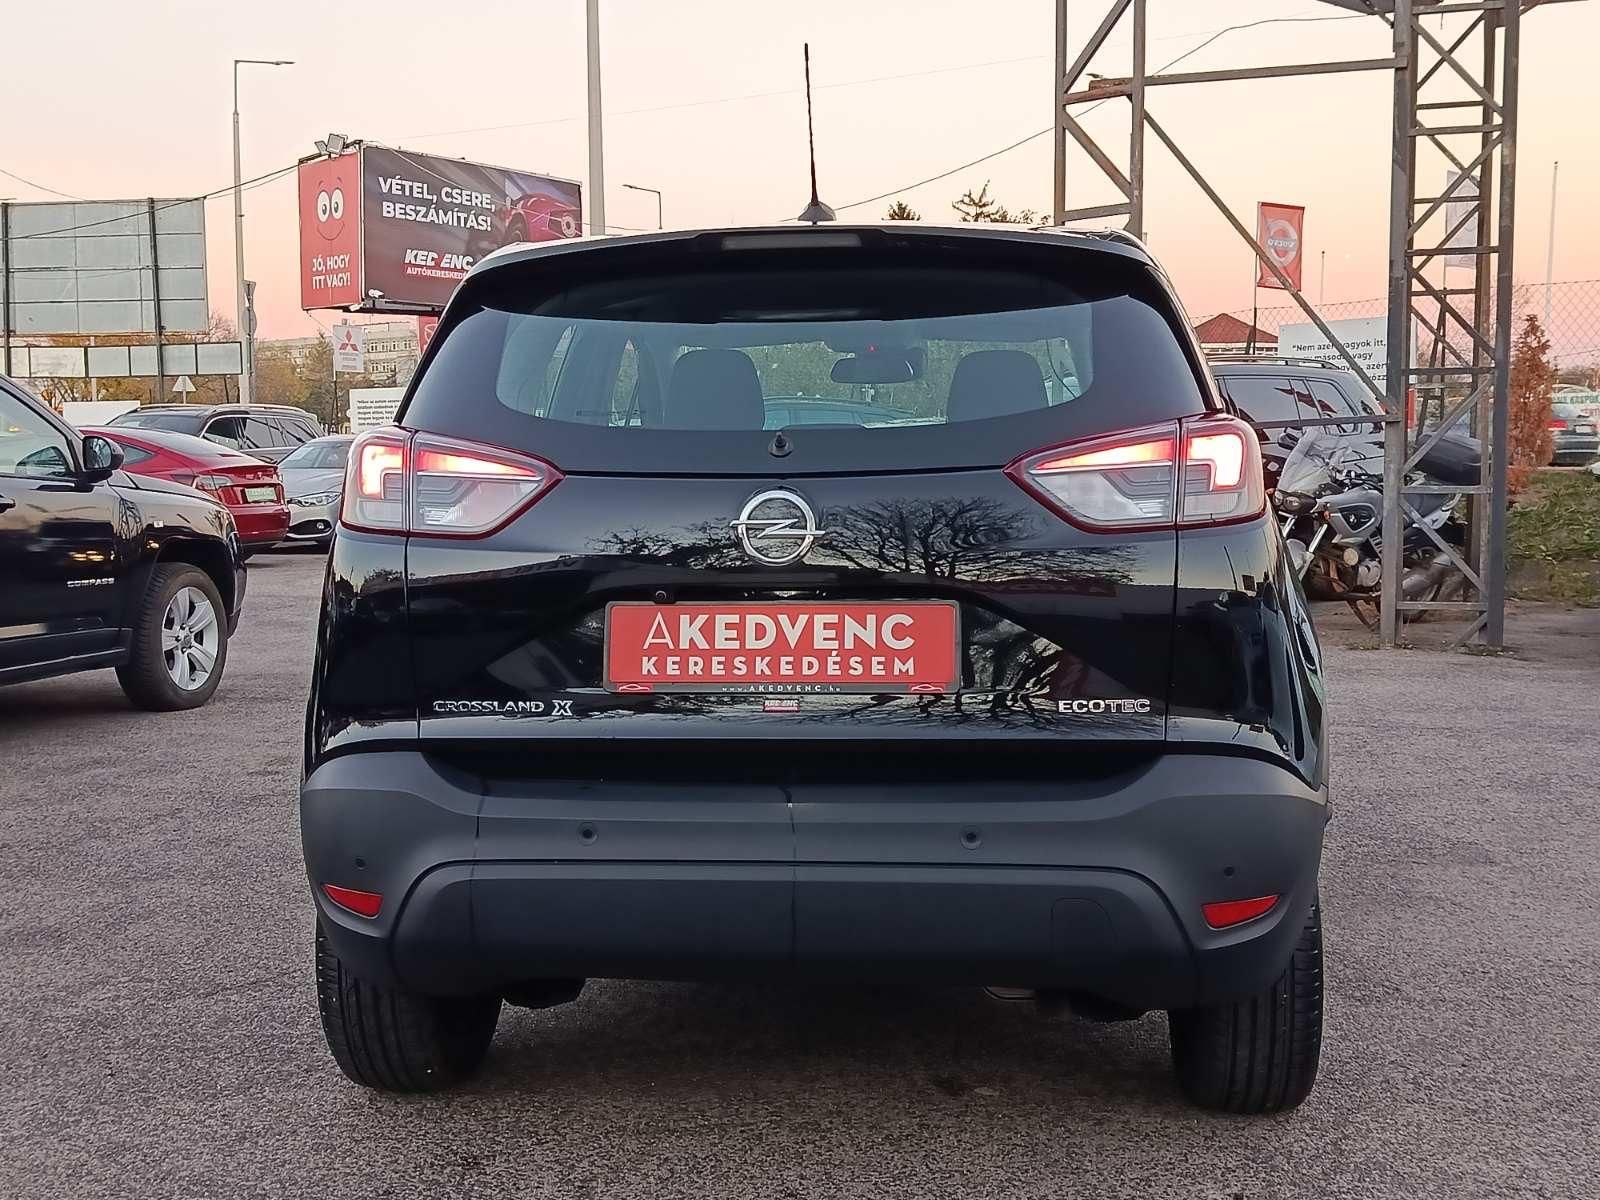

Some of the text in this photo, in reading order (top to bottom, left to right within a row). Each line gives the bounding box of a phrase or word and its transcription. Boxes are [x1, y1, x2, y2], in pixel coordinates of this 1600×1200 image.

[378, 175, 496, 212] VÉTEL, CSERE,
[382, 201, 492, 232] BESZÁMÍTÁS!
[312, 254, 350, 274] JÓ, HOGY
[312, 272, 351, 290] ITT VAGY!
[406, 266, 467, 281] AUTÓKERESKED
[1341, 339, 1372, 350] agyok
[1366, 361, 1386, 371] azér
[67, 577, 115, 588] COMPASS
[641, 650, 916, 676] KERESKEDÉSEM
[433, 699, 574, 716] CROSSLAND X
[1058, 698, 1150, 713] ECOTEC
